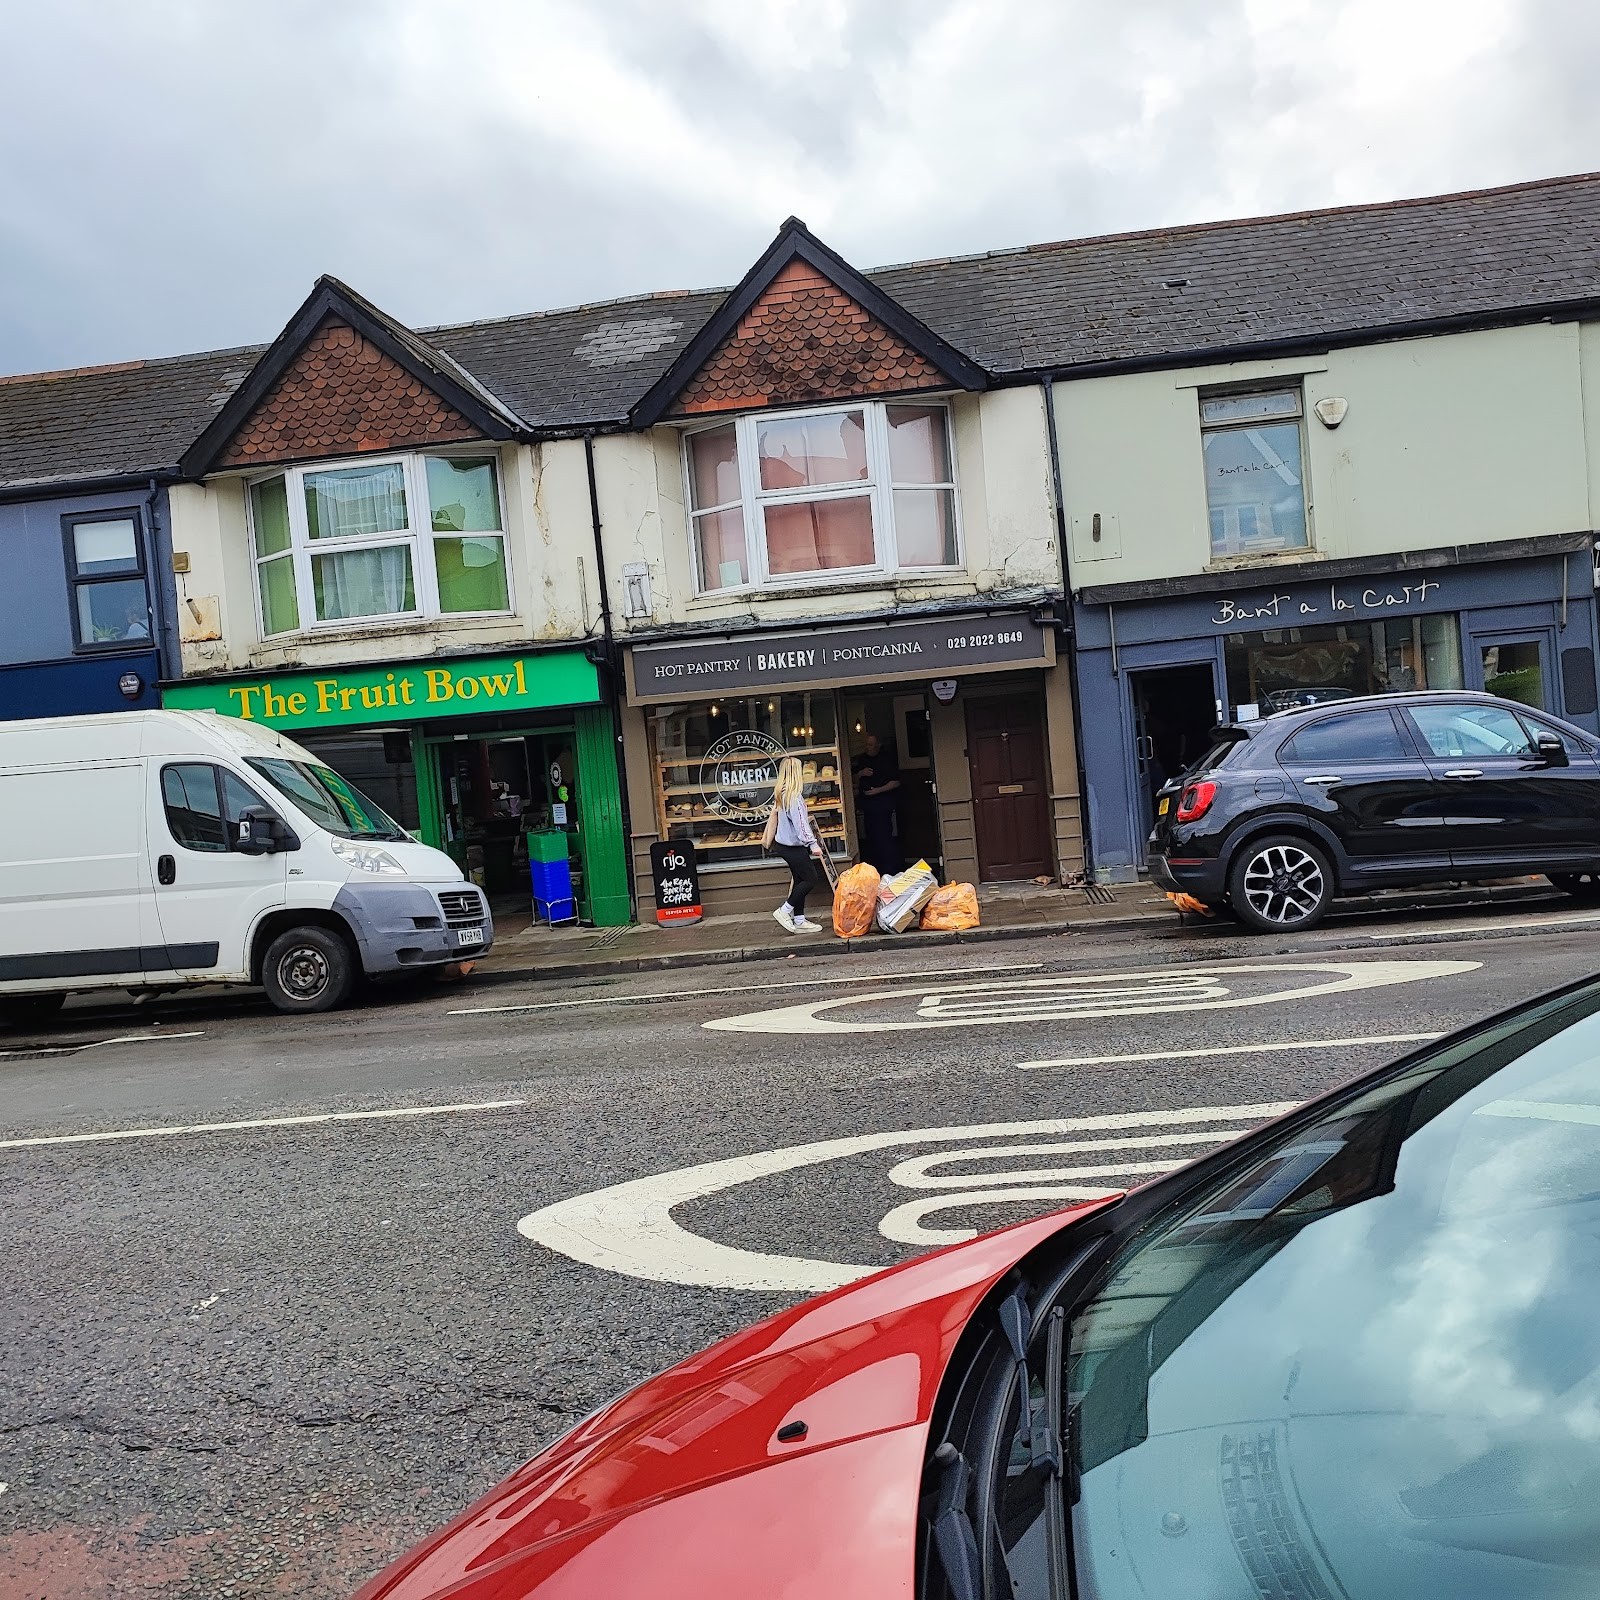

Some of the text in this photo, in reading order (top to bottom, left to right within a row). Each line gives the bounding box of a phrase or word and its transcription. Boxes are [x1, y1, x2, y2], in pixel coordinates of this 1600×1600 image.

[1211, 578, 1440, 624] Bant a la Cart
[654, 631, 1024, 678] HOT PANTRY BAKERY PONTCANNA 029 2022 8649
[229, 660, 529, 719] The Fruit Bowl
[709, 734, 782, 762] HOT PANTRY
[721, 767, 771, 786] BAKERY
[662, 850, 685, 871] rijo
